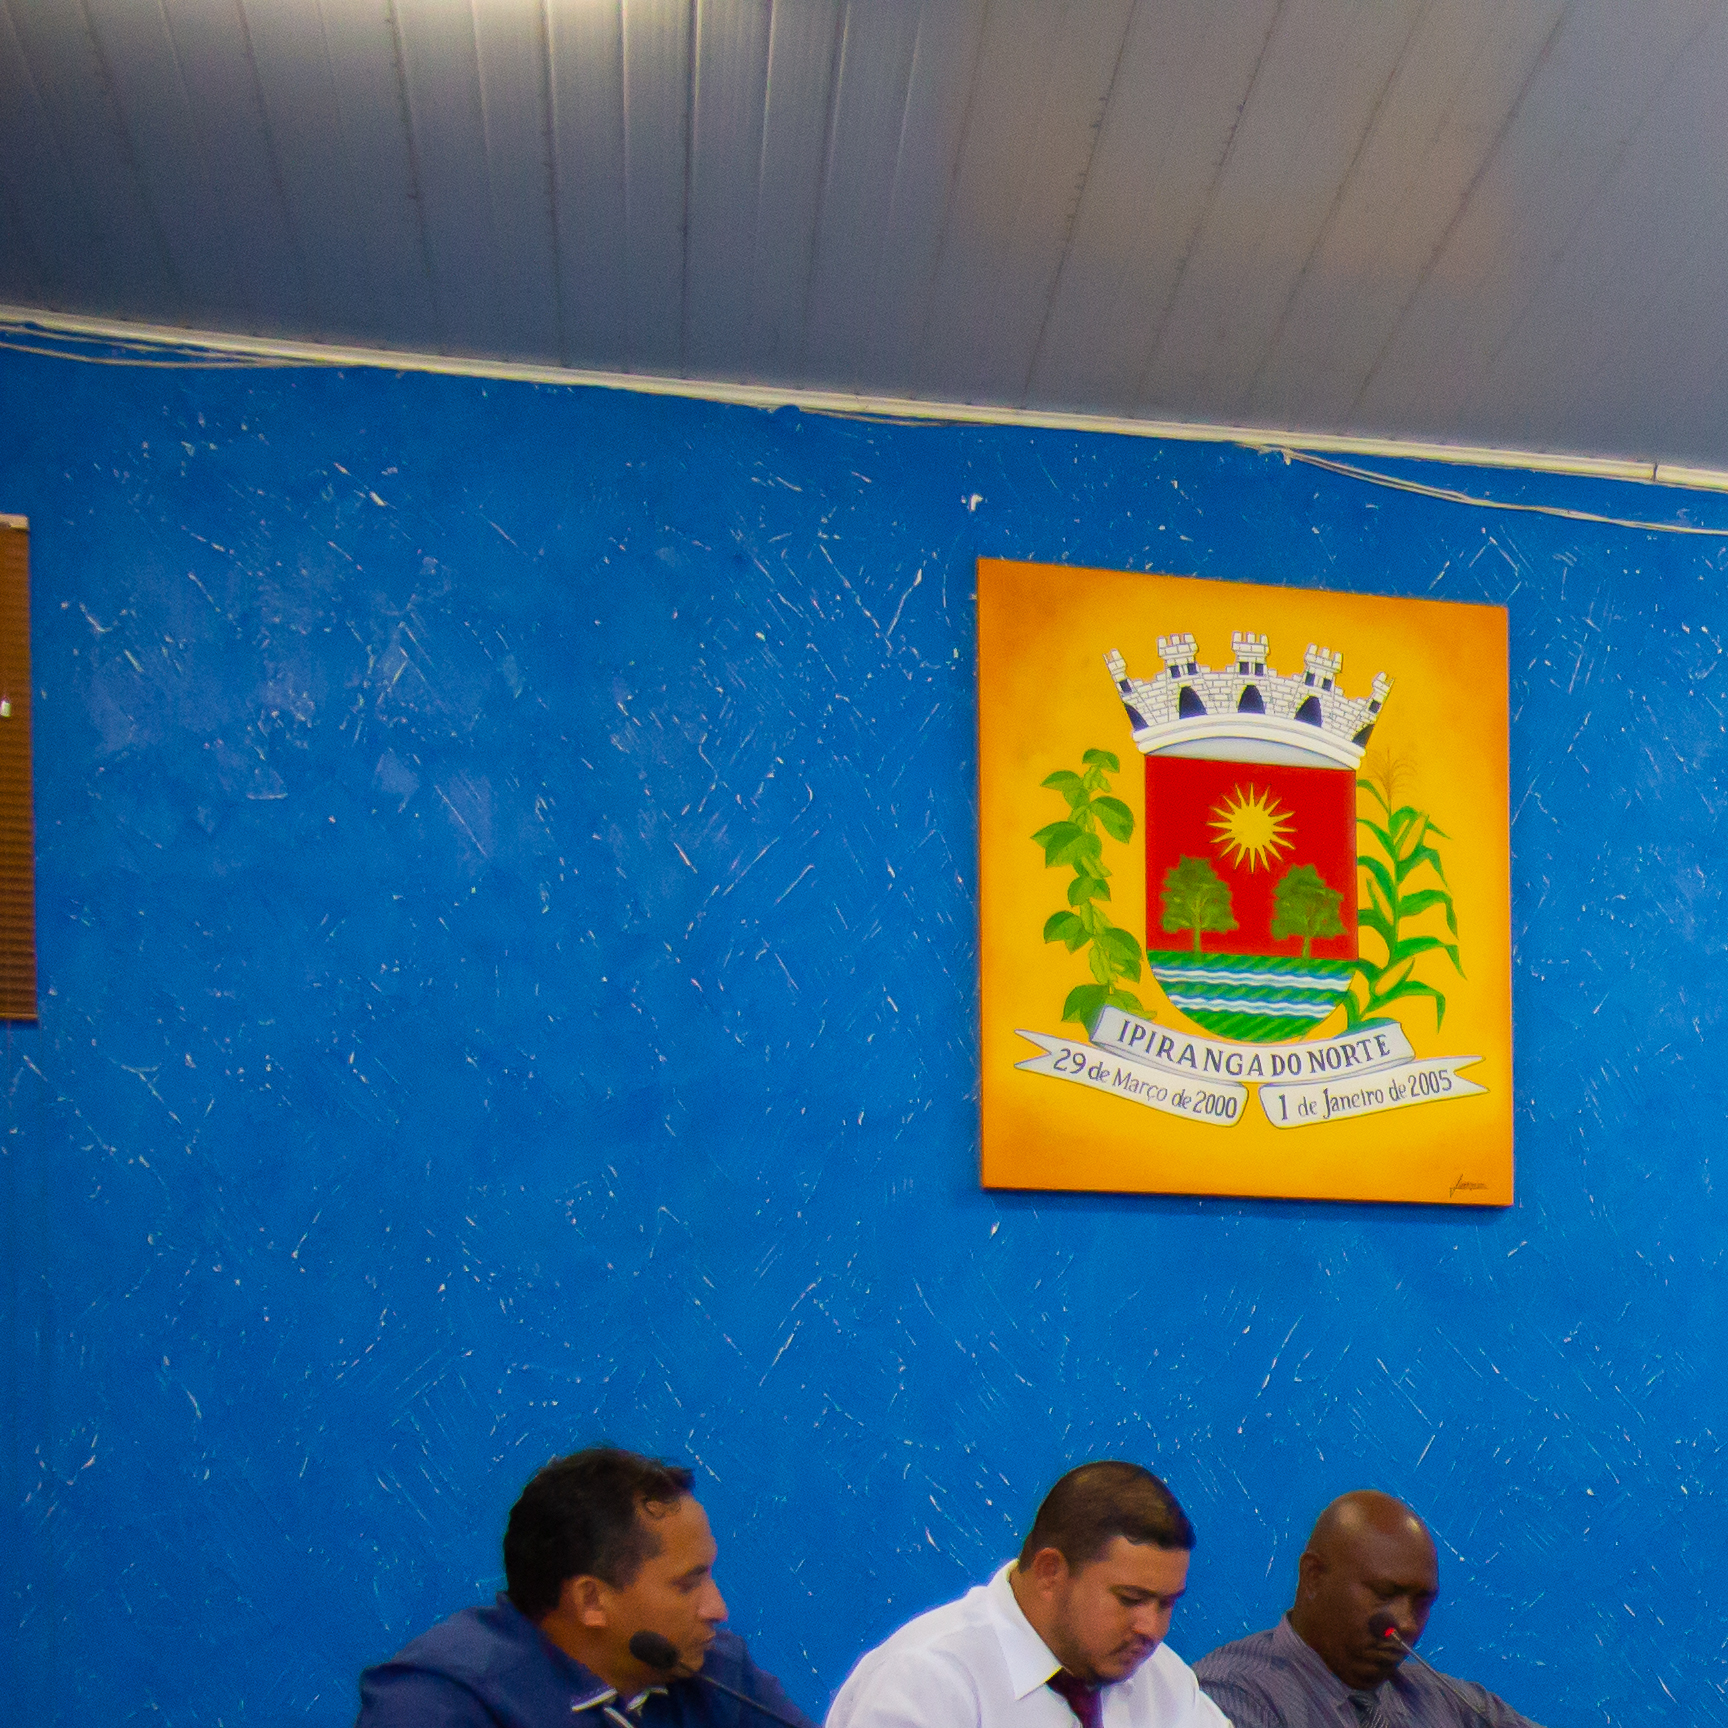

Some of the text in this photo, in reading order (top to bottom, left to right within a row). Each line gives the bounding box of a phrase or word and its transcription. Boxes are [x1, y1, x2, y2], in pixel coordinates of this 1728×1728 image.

[1117, 1018, 1390, 1077] IPIRANGA DO NORTE
[1053, 1048, 1238, 1119] 29 de Março de 2000
[1278, 1093, 1289, 1121] 1
[1298, 1096, 1318, 1117] de
[1388, 1078, 1407, 1101] de
[1407, 1069, 1453, 1098] 2005
